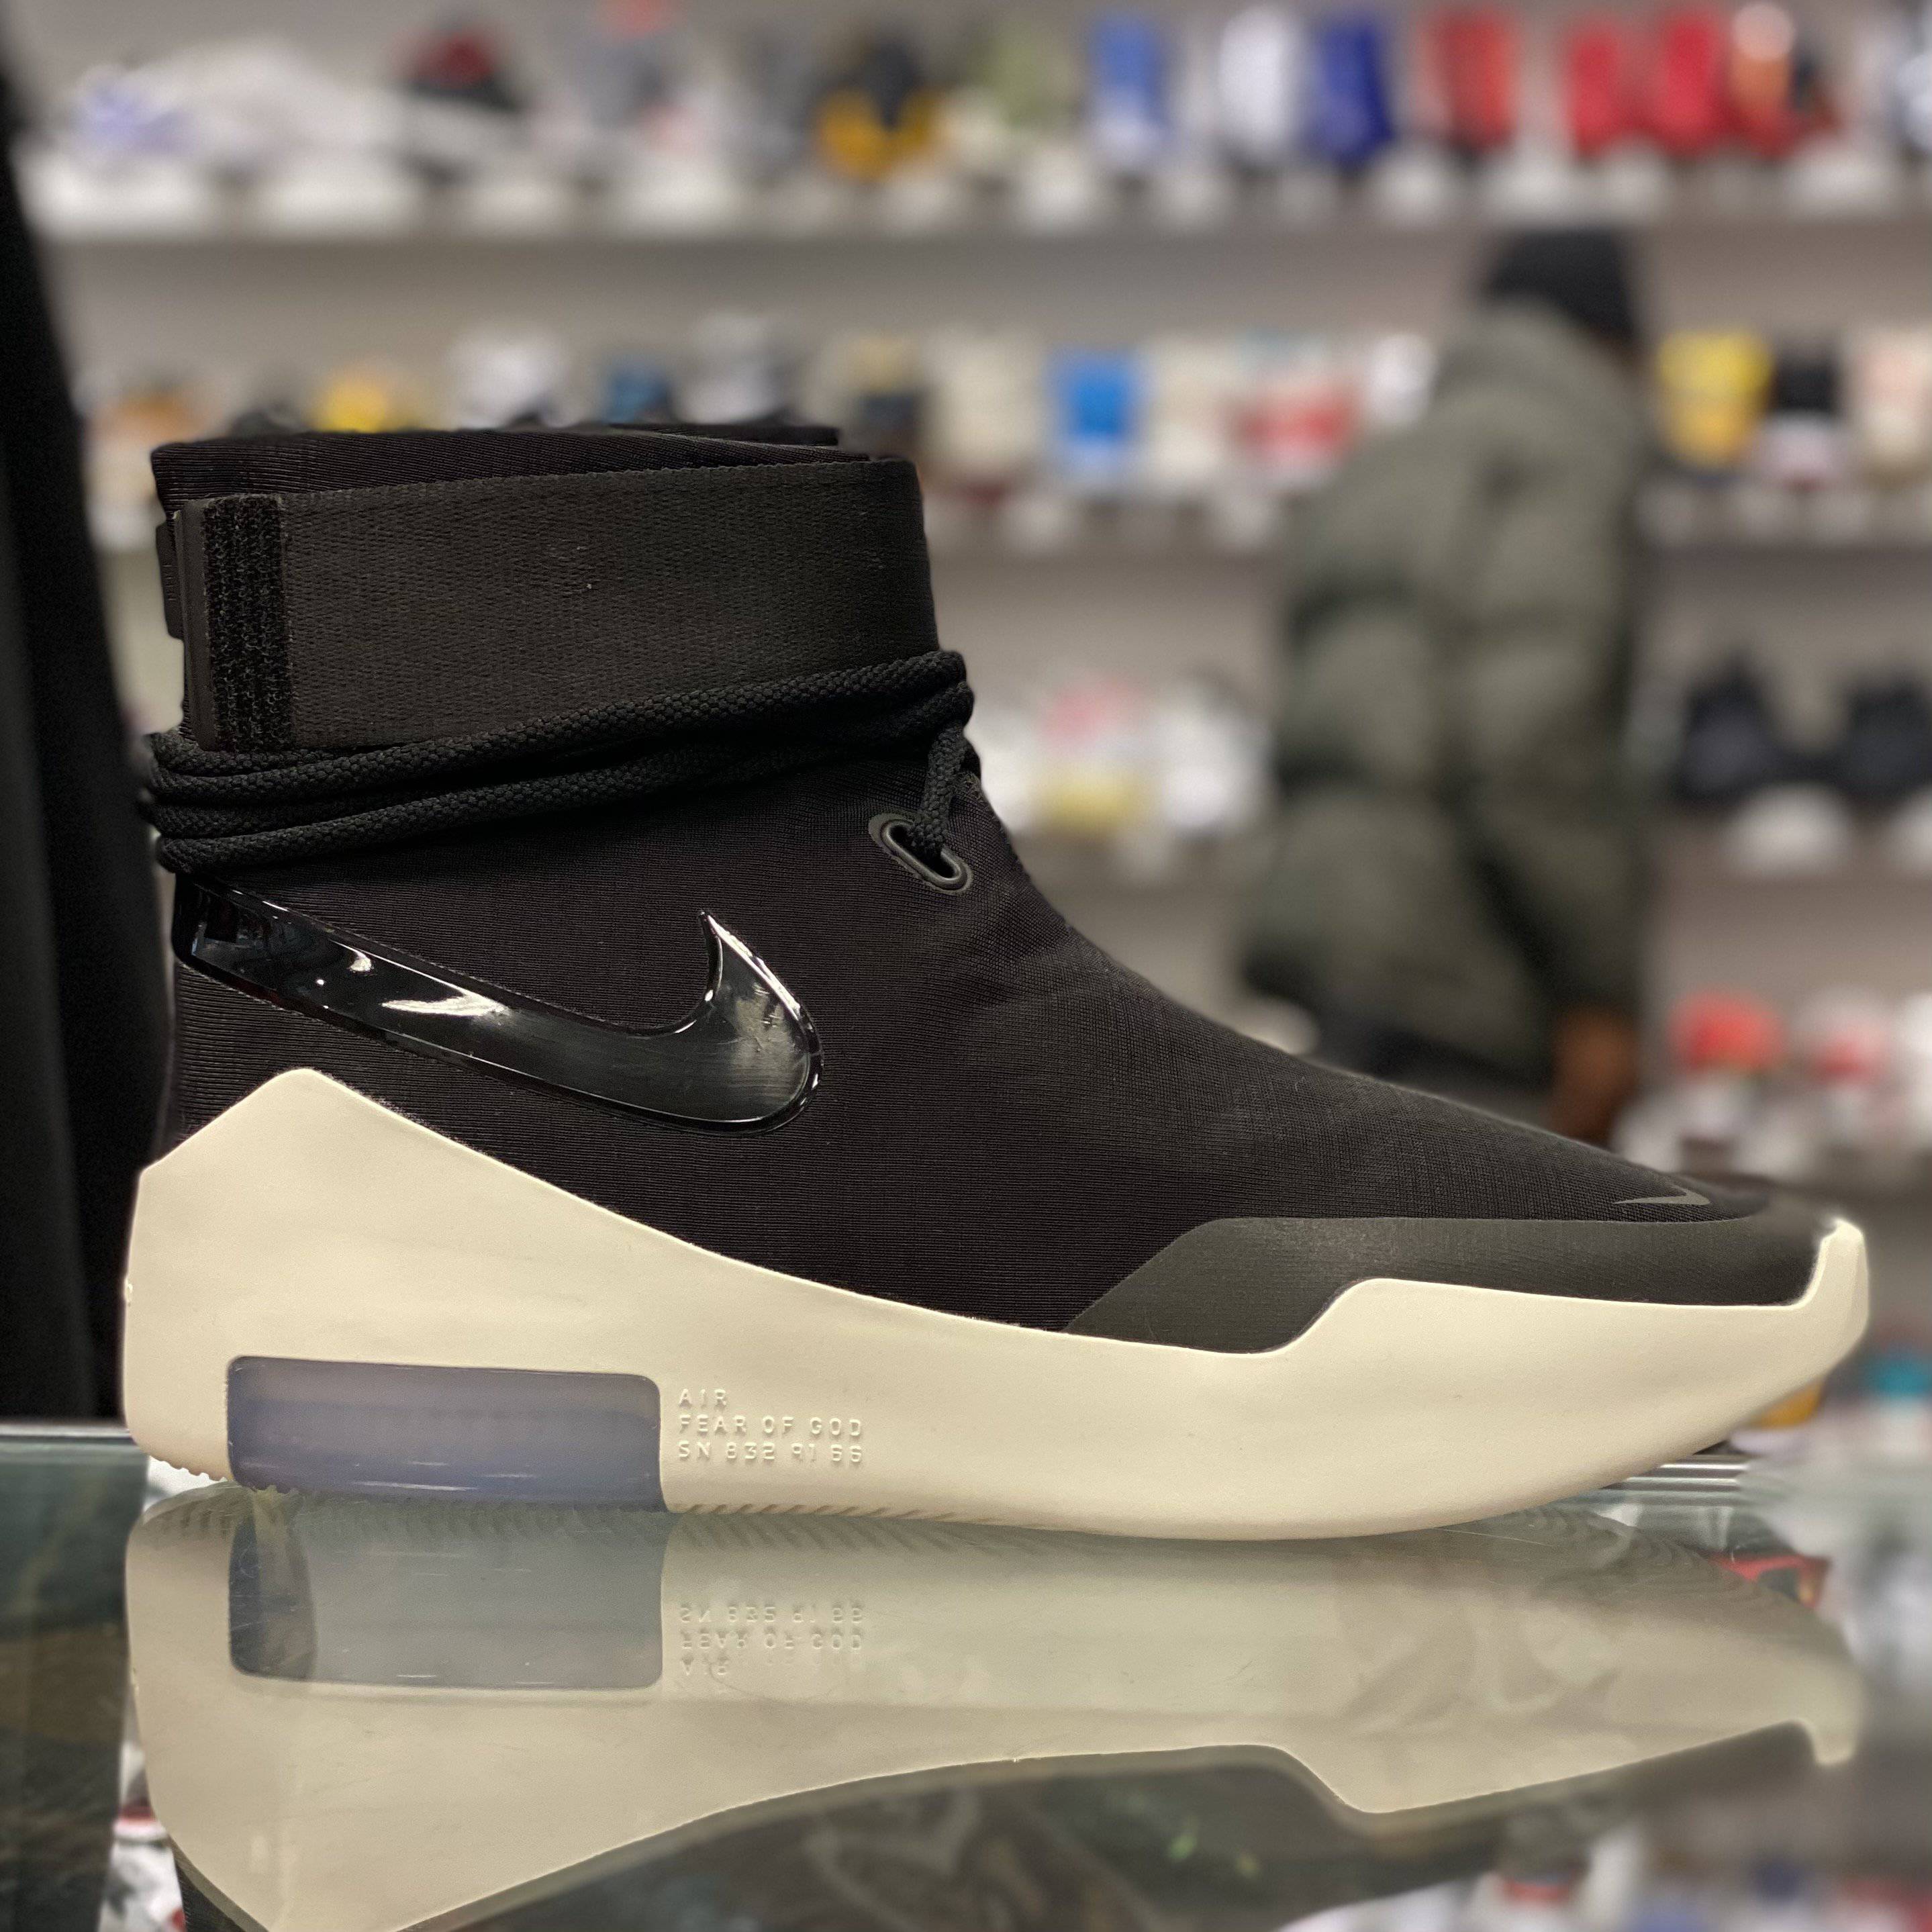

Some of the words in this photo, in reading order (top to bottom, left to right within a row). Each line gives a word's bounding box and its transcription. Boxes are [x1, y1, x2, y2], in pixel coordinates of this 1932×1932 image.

[679, 1388, 727, 1408] AIR
[679, 1414, 746, 1435] FEAR
[762, 1416, 795, 1435] OF
[810, 1416, 862, 1437] GOD
[678, 1440, 711, 1460] SN
[726, 1441, 775, 1460] 832
